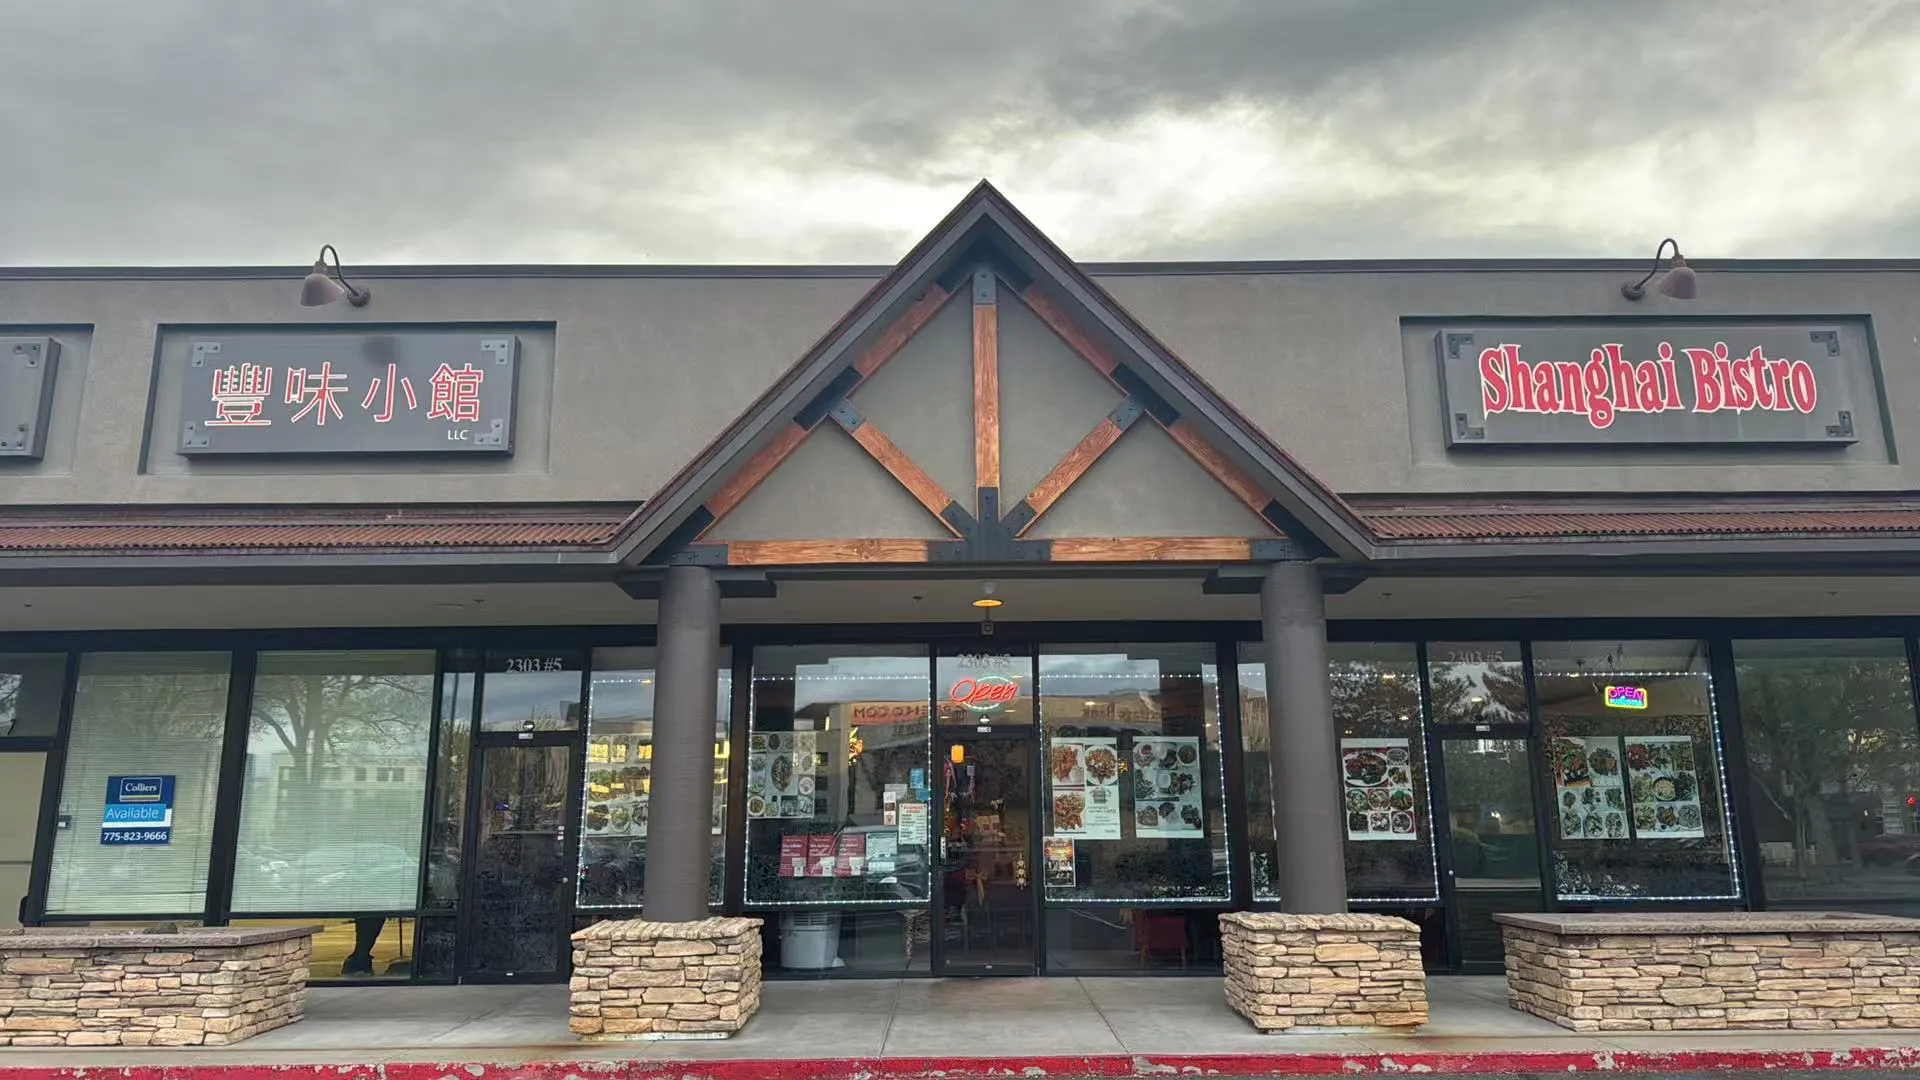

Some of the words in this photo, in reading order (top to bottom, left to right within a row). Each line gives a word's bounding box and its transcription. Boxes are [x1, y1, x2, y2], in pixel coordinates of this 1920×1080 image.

[1478, 342, 1685, 429] Shanghai
[1683, 341, 1817, 415] Bistro
[205, 361, 485, 426] 豐味小館
[447, 429, 469, 440] LLC
[505, 658, 541, 674] 2303
[543, 657, 563, 673] #5
[950, 678, 1018, 706] Open
[1608, 686, 1643, 700] OPEN
[125, 782, 158, 792] Colliers
[105, 807, 160, 819] Available
[103, 831, 168, 841] 775-823-9666
